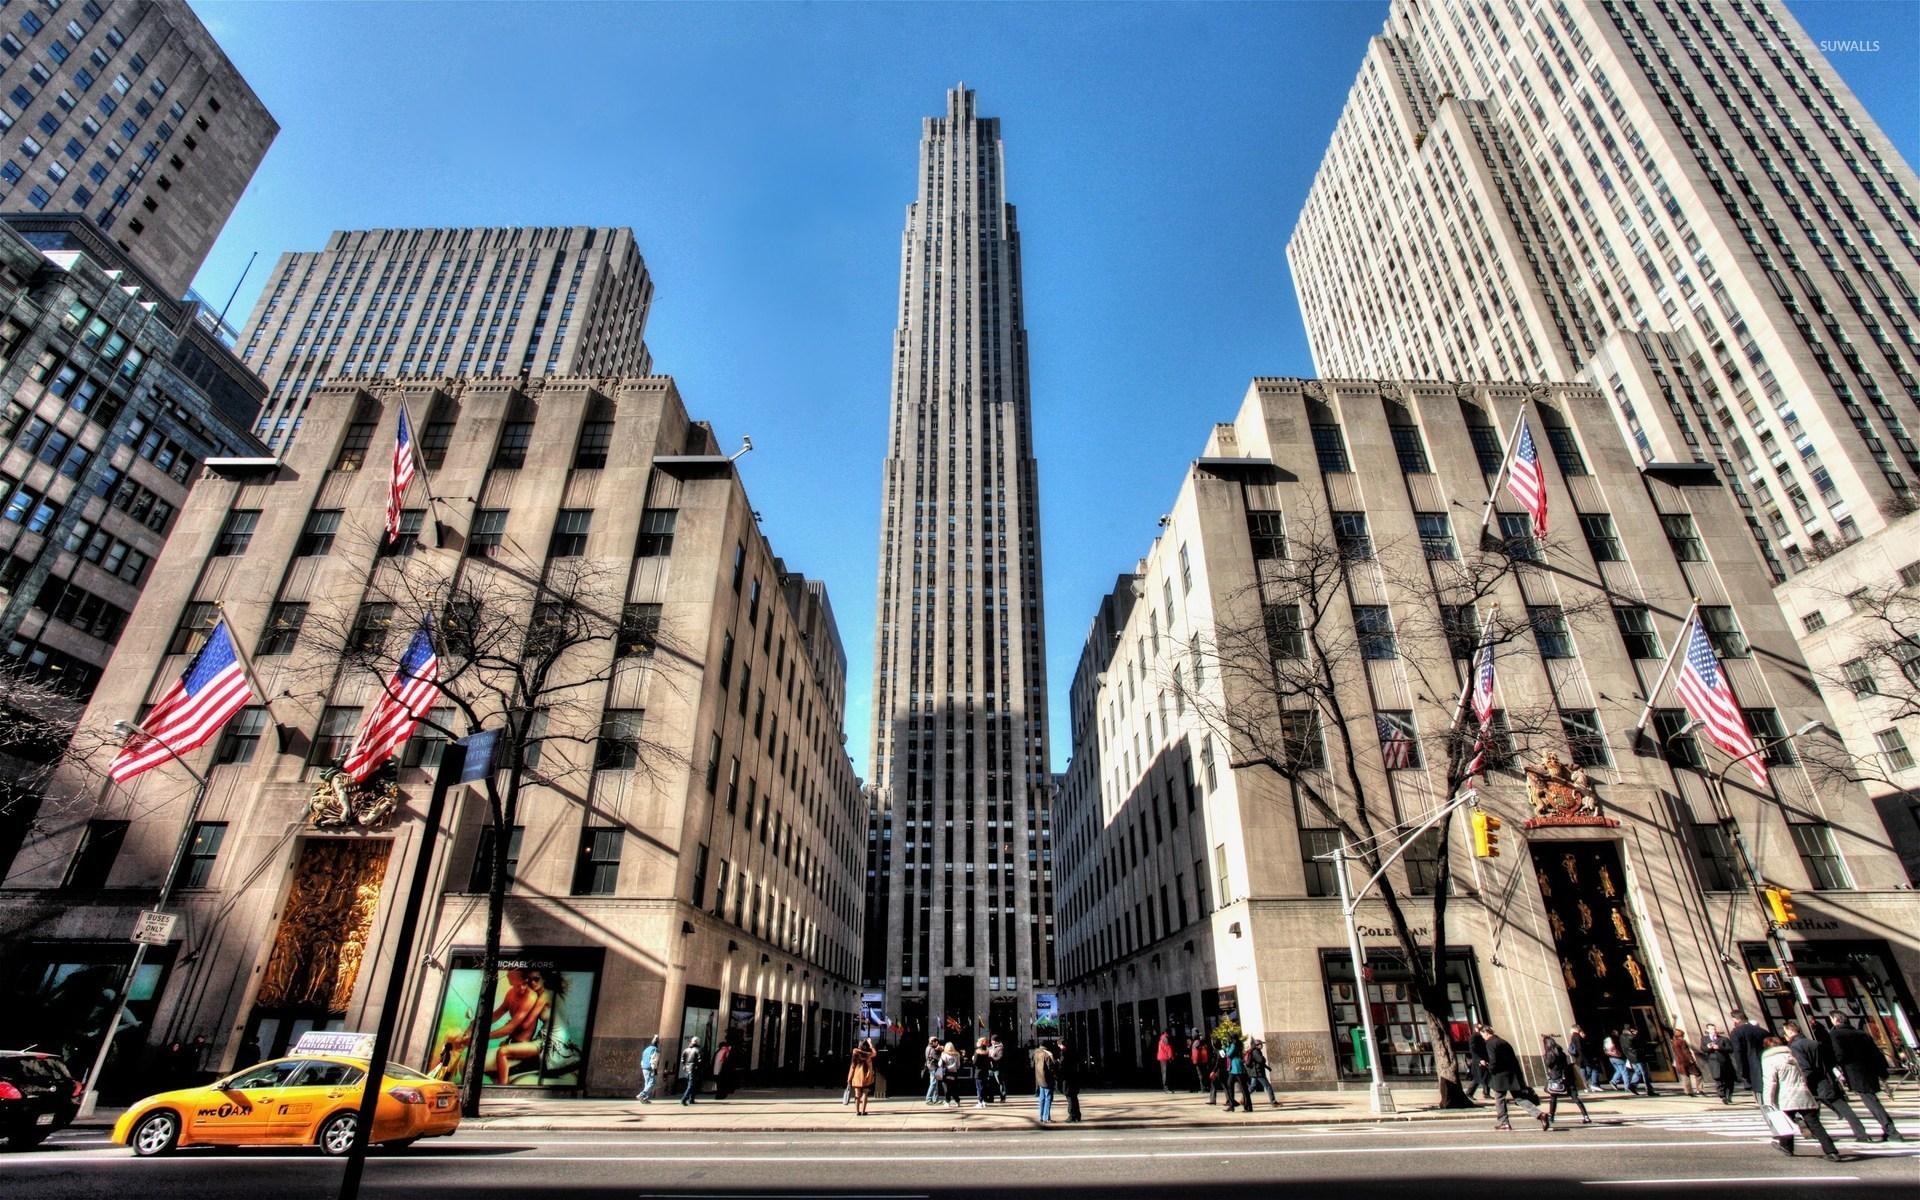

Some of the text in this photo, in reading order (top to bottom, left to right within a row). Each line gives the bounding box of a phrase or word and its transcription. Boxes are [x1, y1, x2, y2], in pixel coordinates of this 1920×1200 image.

[147, 913, 170, 923] BUSES
[145, 925, 165, 933] ONLY
[531, 961, 554, 969] KORS
[302, 1033, 334, 1044] PRIVATE
[197, 1103, 251, 1118] NYC TAXI
